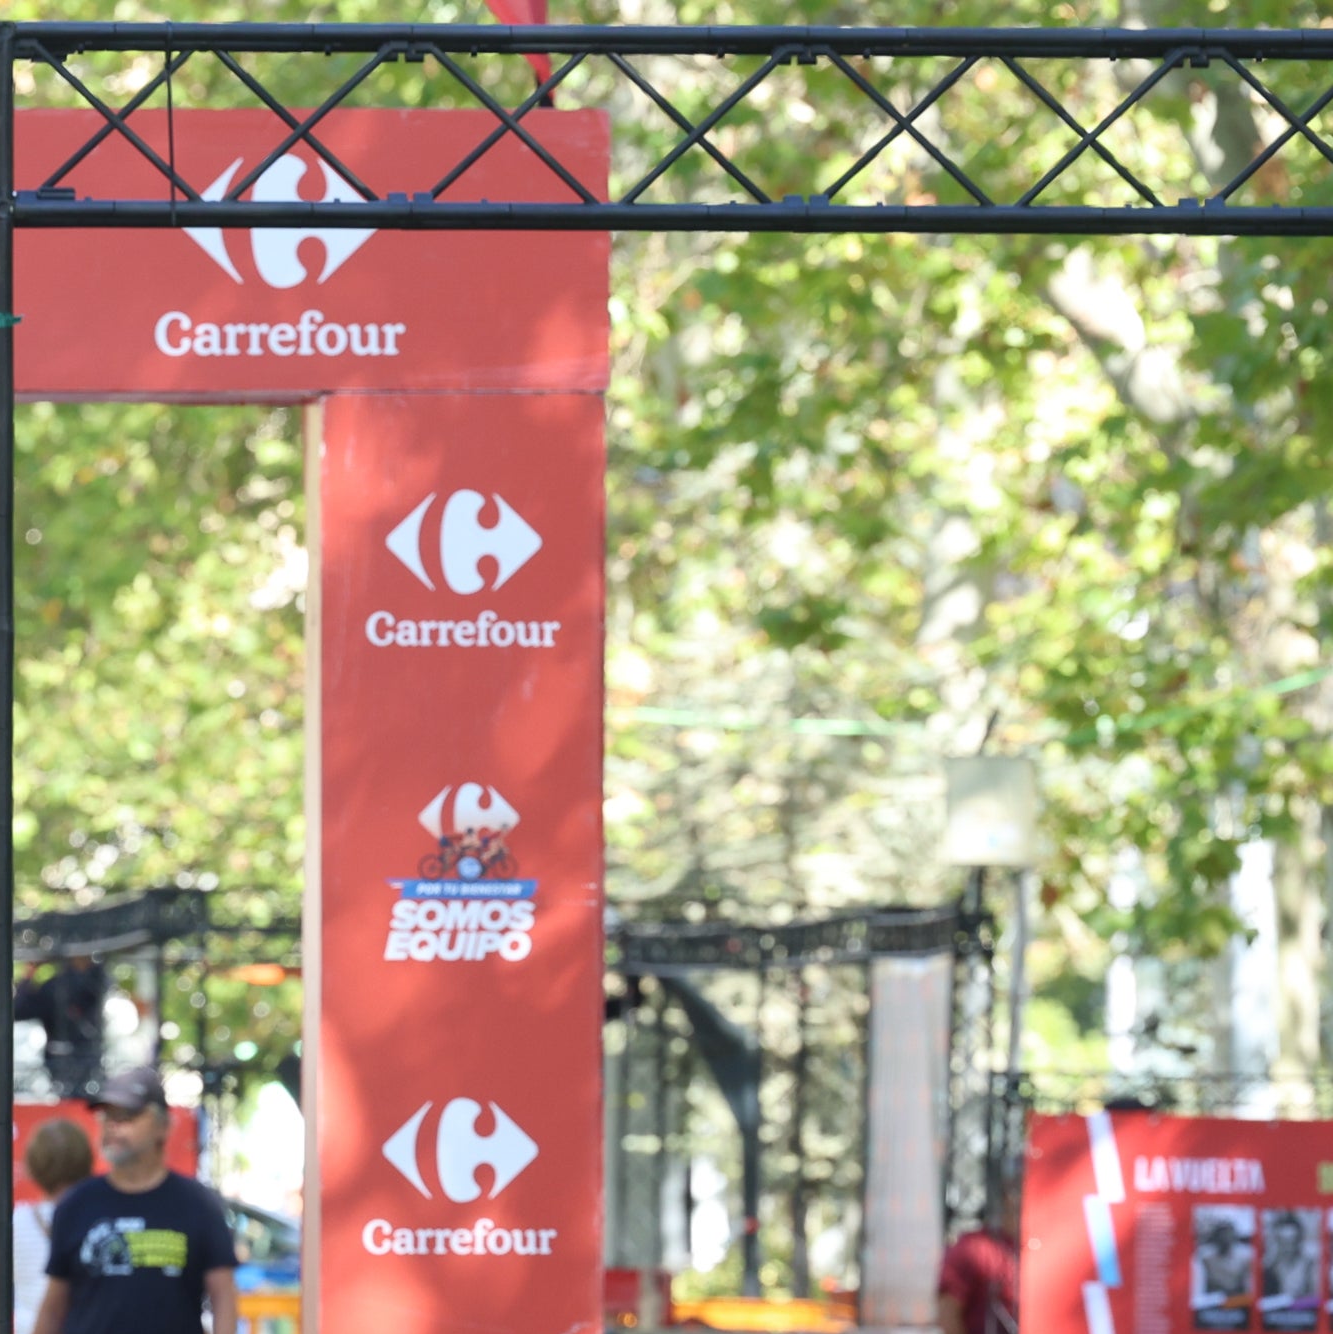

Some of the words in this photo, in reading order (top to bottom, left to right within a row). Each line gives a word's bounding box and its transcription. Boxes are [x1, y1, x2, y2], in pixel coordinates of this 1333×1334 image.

[154, 309, 405, 356] Carrefour
[365, 610, 559, 647] Carrefour
[390, 899, 535, 932] SOMOS
[383, 930, 532, 962] EQUIPO
[362, 1218, 557, 1256] Carrefour
